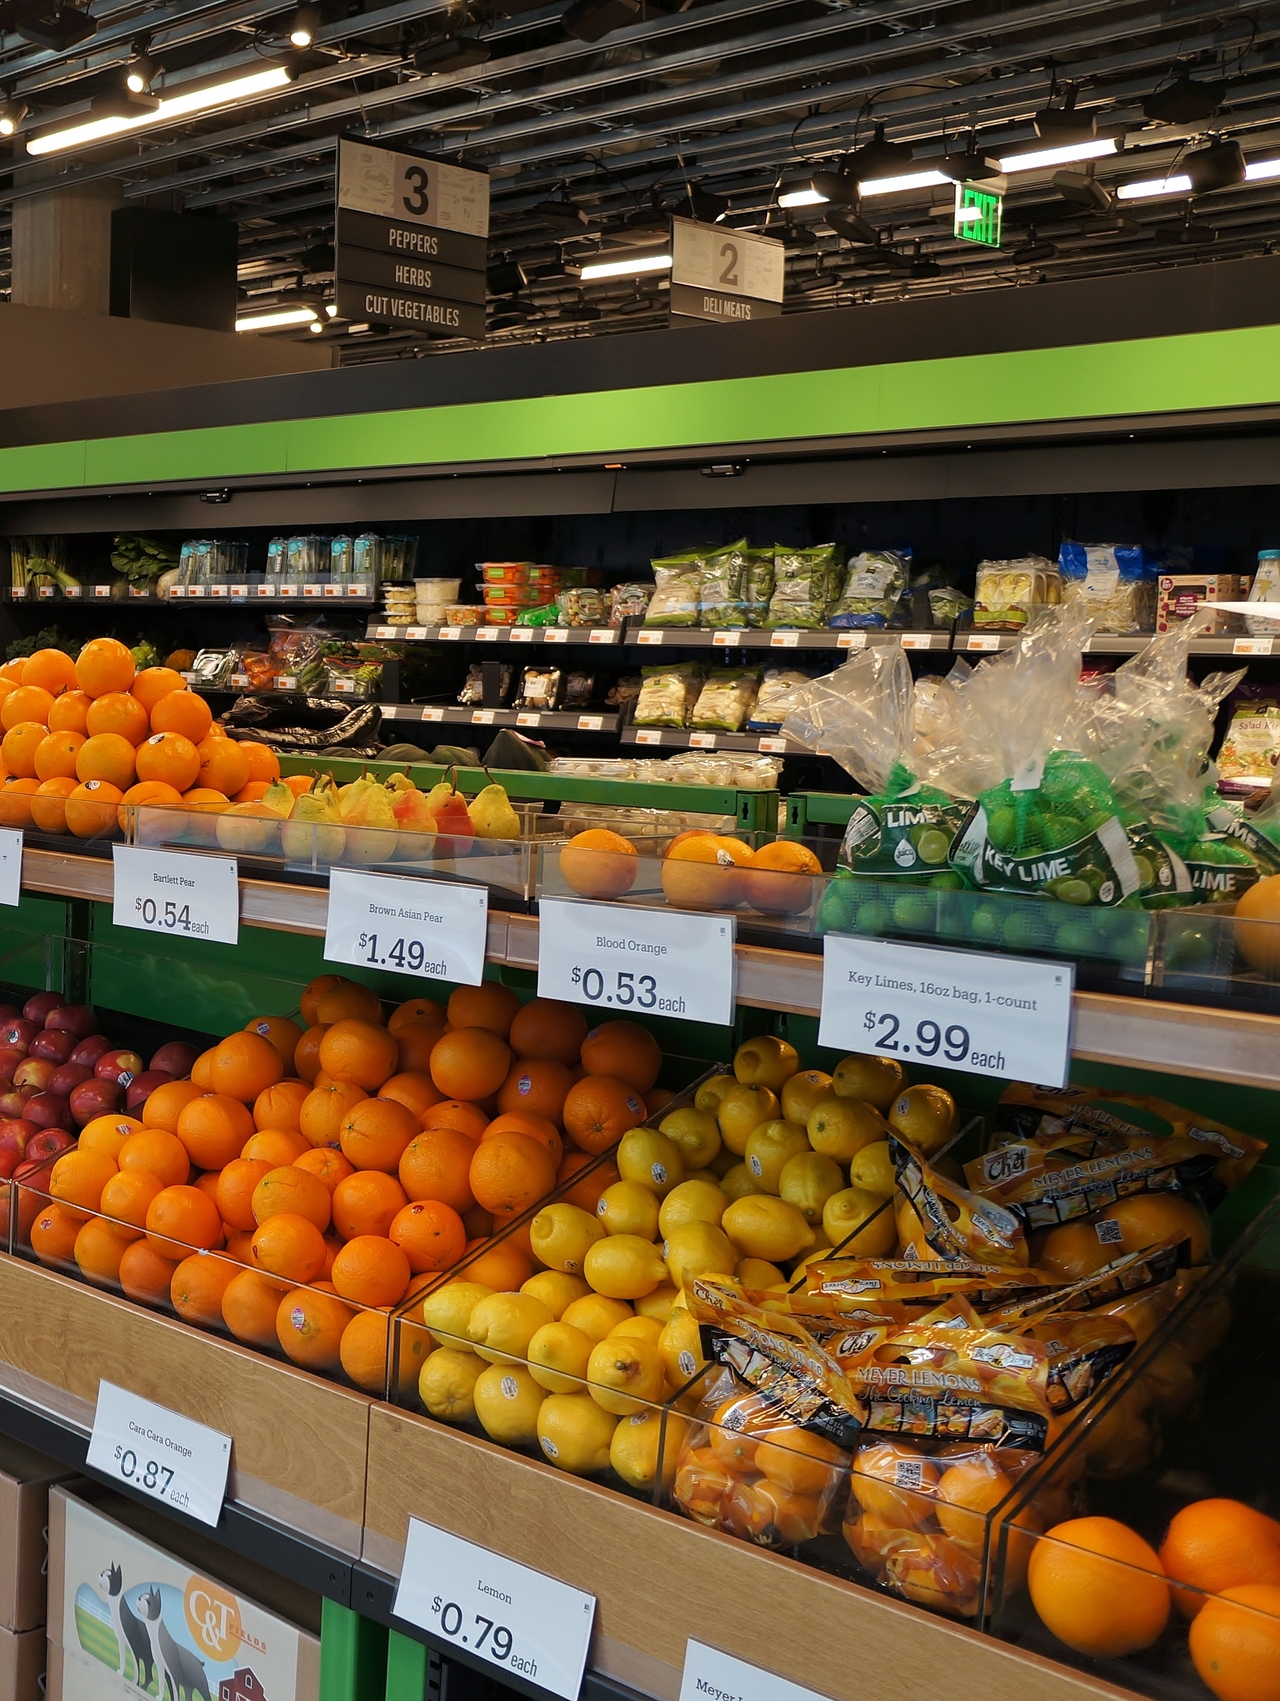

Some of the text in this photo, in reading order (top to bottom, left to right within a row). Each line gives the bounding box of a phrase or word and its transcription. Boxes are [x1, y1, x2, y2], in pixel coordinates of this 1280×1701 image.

[403, 165, 429, 216] 3
[963, 189, 997, 244] EXIT
[389, 228, 438, 255] PEPPERS
[395, 264, 431, 288] HERBS
[719, 242, 738, 287] 2
[365, 294, 459, 327] CUT VEGETABLES
[703, 296, 751, 320] DELI MEATS
[1239, 721, 1262, 730] Salad
[153, 873, 195, 887] Bartlett Pear
[984, 844, 1016, 877] KEY
[1018, 857, 1072, 882] LIME
[1192, 870, 1238, 892] LIME
[135, 897, 191, 931] $0.54
[369, 903, 444, 924] Brown Asian Pear
[359, 931, 425, 970] $1.49
[596, 936, 667, 956] Blood Orange
[571, 965, 686, 1013] $0.53 each
[848, 970, 1038, 1012] Key Limes, 16oz bag, 1-count
[863, 1009, 1006, 1071] $2.99 each
[987, 1148, 1029, 1182] Chef
[1032, 1147, 1155, 1188] MEYER LEMONS
[856, 1368, 982, 1393] MEYER LEMONS
[858, 1385, 982, 1412] The Cooking Lemon
[128, 1420, 193, 1458] Cara Cara Orange
[114, 1444, 190, 1508] $0.87 each
[477, 1579, 513, 1605] Lemon
[189, 1590, 267, 1652] C&T FIELDS
[431, 1595, 539, 1677] $0.79 each
